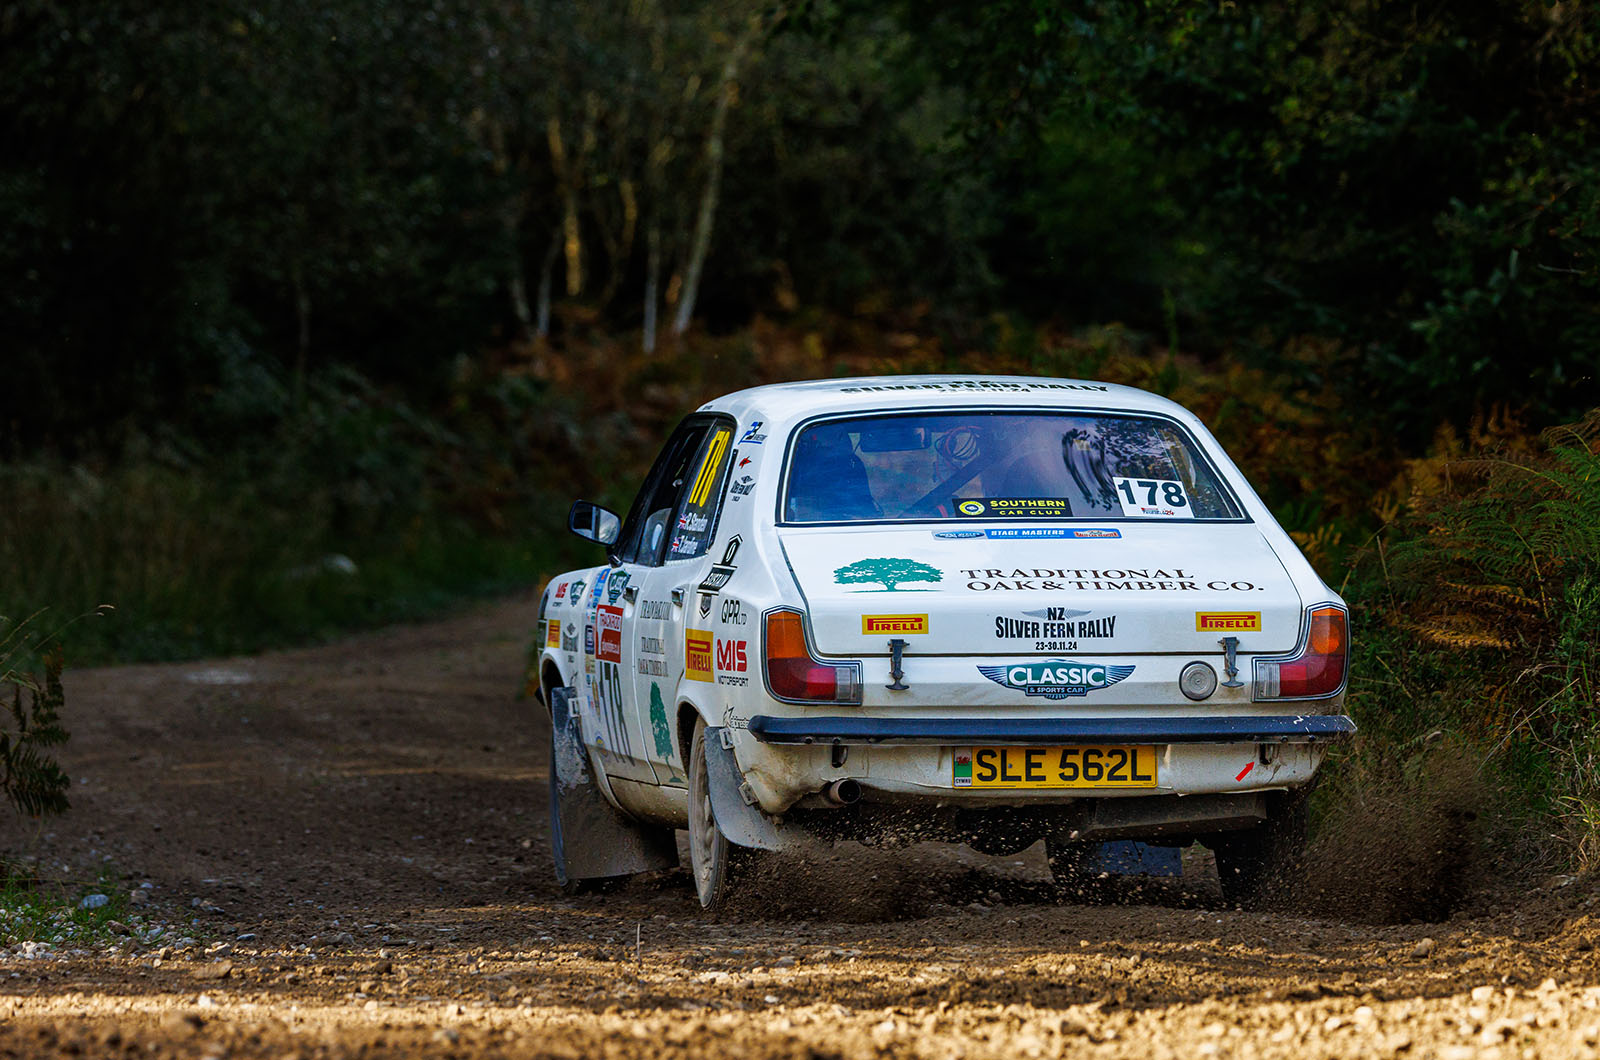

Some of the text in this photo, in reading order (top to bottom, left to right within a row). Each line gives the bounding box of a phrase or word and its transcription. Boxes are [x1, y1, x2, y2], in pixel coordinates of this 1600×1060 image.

[1028, 383, 1109, 393] RALLY
[1117, 479, 1188, 508] 178
[990, 500, 1065, 508] SOUTHERN
[960, 568, 1194, 579] TRADITIONAL
[967, 581, 1037, 591] OAK
[1068, 581, 1200, 590] TIMBER
[1207, 581, 1264, 592] CO.
[1046, 607, 1065, 620] NZ
[867, 617, 922, 631] PIRELLI
[995, 615, 1116, 638] SILVER FERN RALLY
[1201, 615, 1256, 629] PIRELLI
[1035, 642, 1078, 651] 23-30.11.24
[687, 639, 711, 673] PIRELLI
[717, 639, 747, 672] MIS
[718, 675, 748, 687] MOTORSPORT
[1008, 666, 1105, 686] CLASSIC
[976, 749, 1152, 782] SLE 562L
